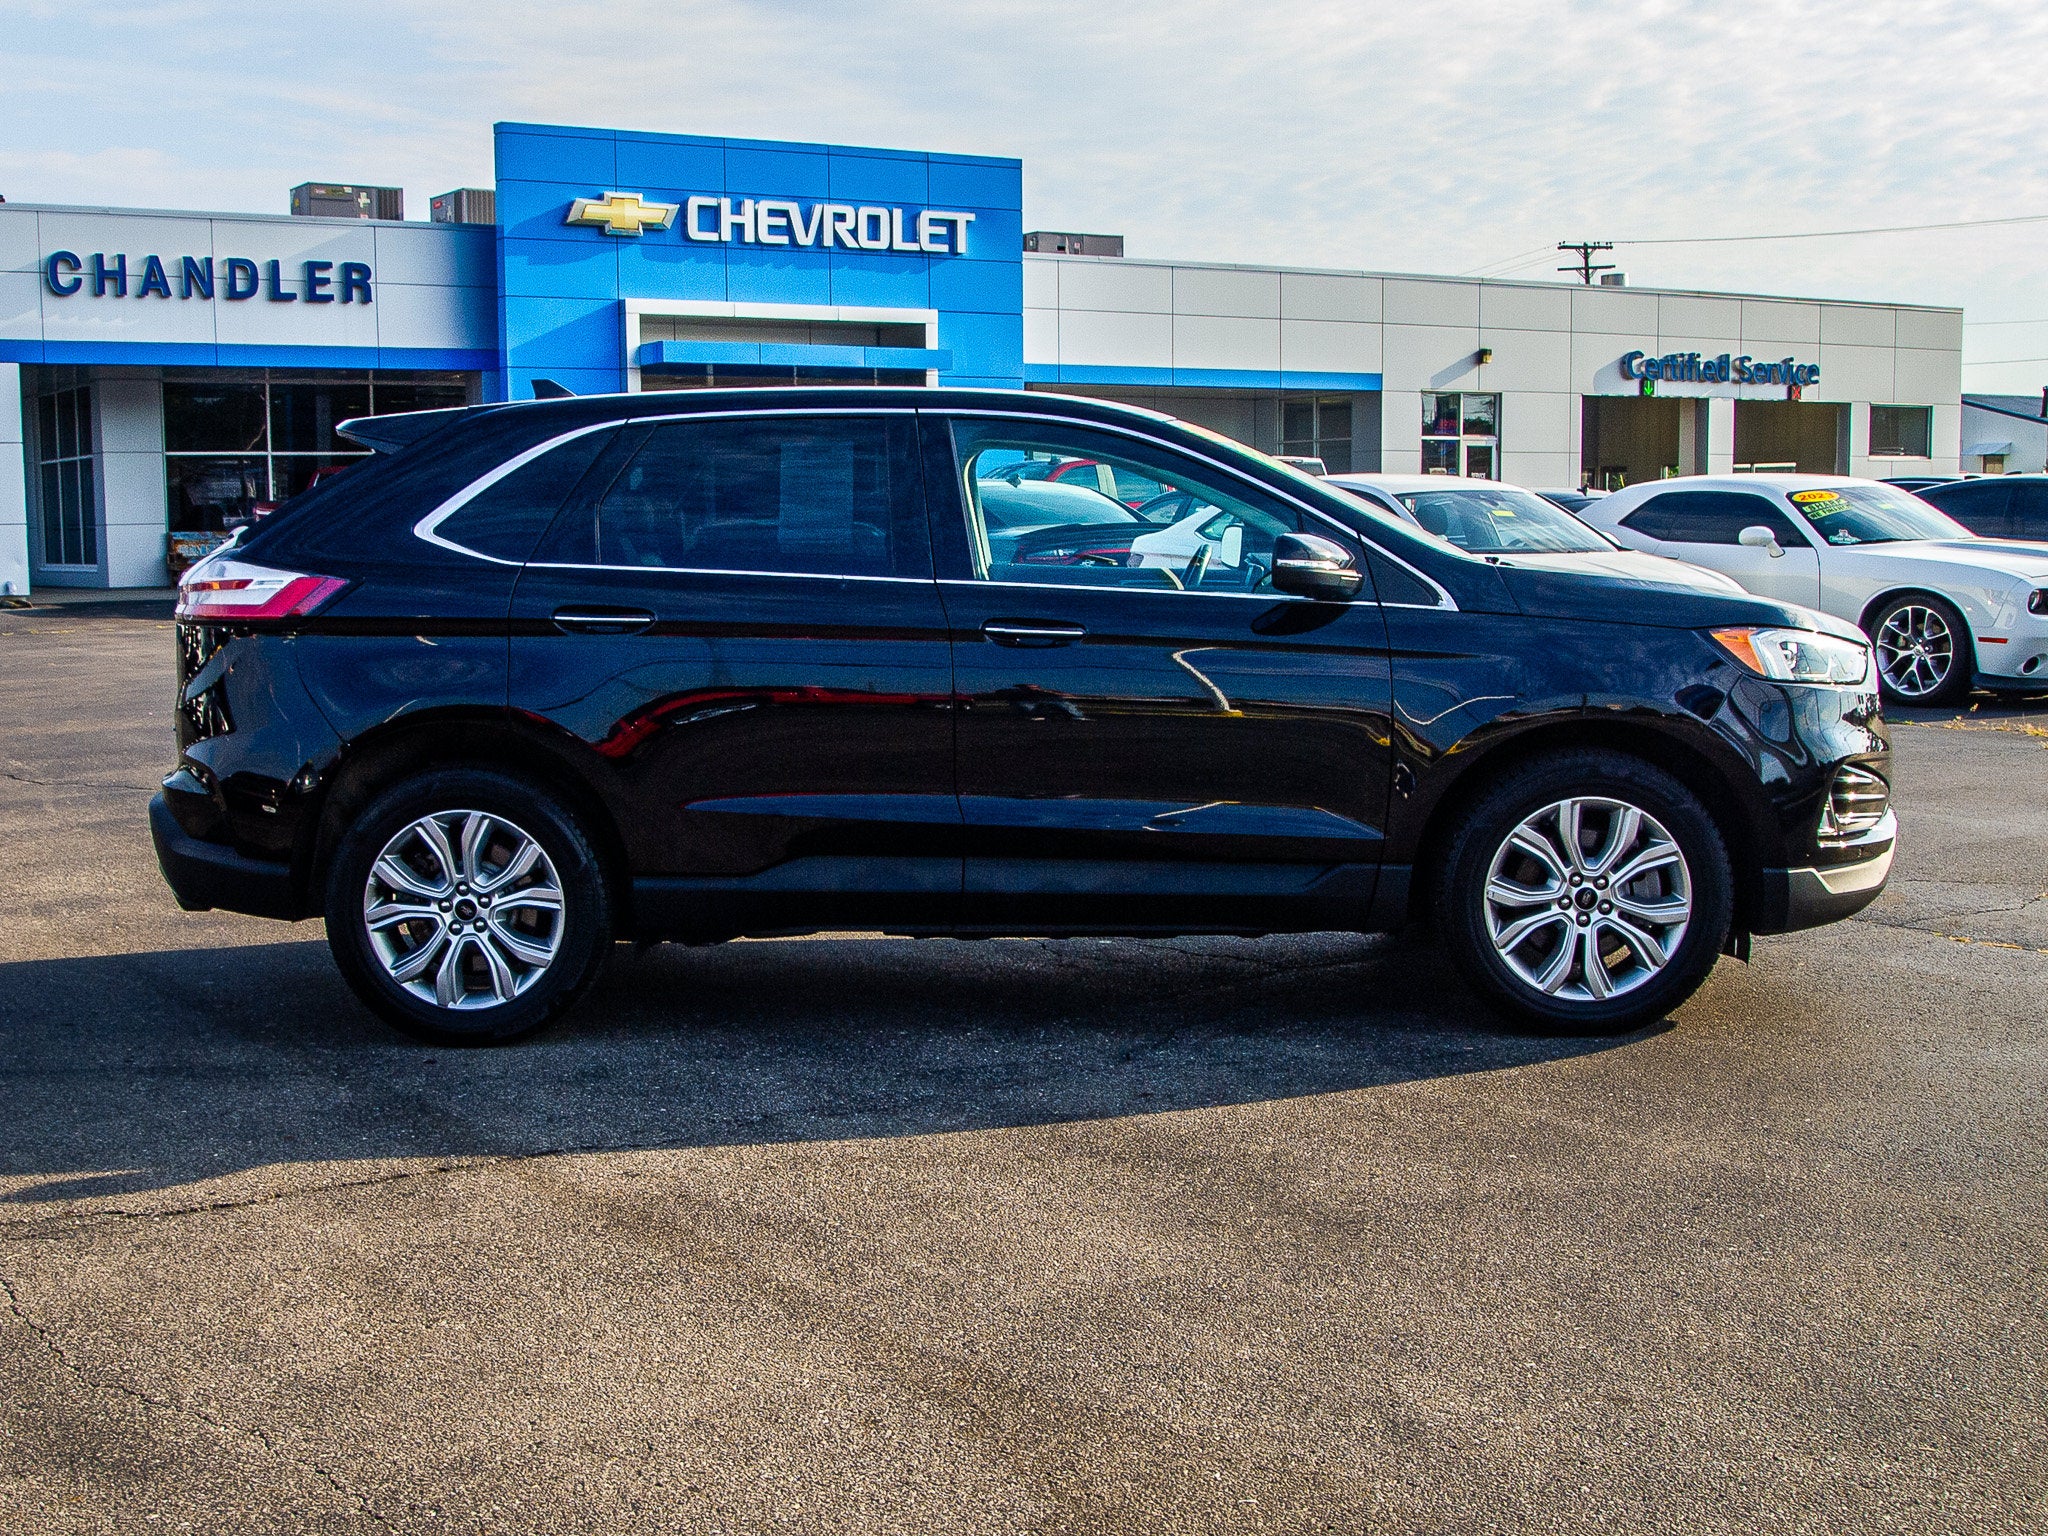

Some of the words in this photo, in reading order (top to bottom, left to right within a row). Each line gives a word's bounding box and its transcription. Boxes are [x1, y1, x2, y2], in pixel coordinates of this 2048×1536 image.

[687, 195, 976, 254] CHEVROLET
[47, 250, 374, 303] CHANDLER
[1624, 350, 1731, 383] Certified
[1735, 354, 1821, 386] Service
